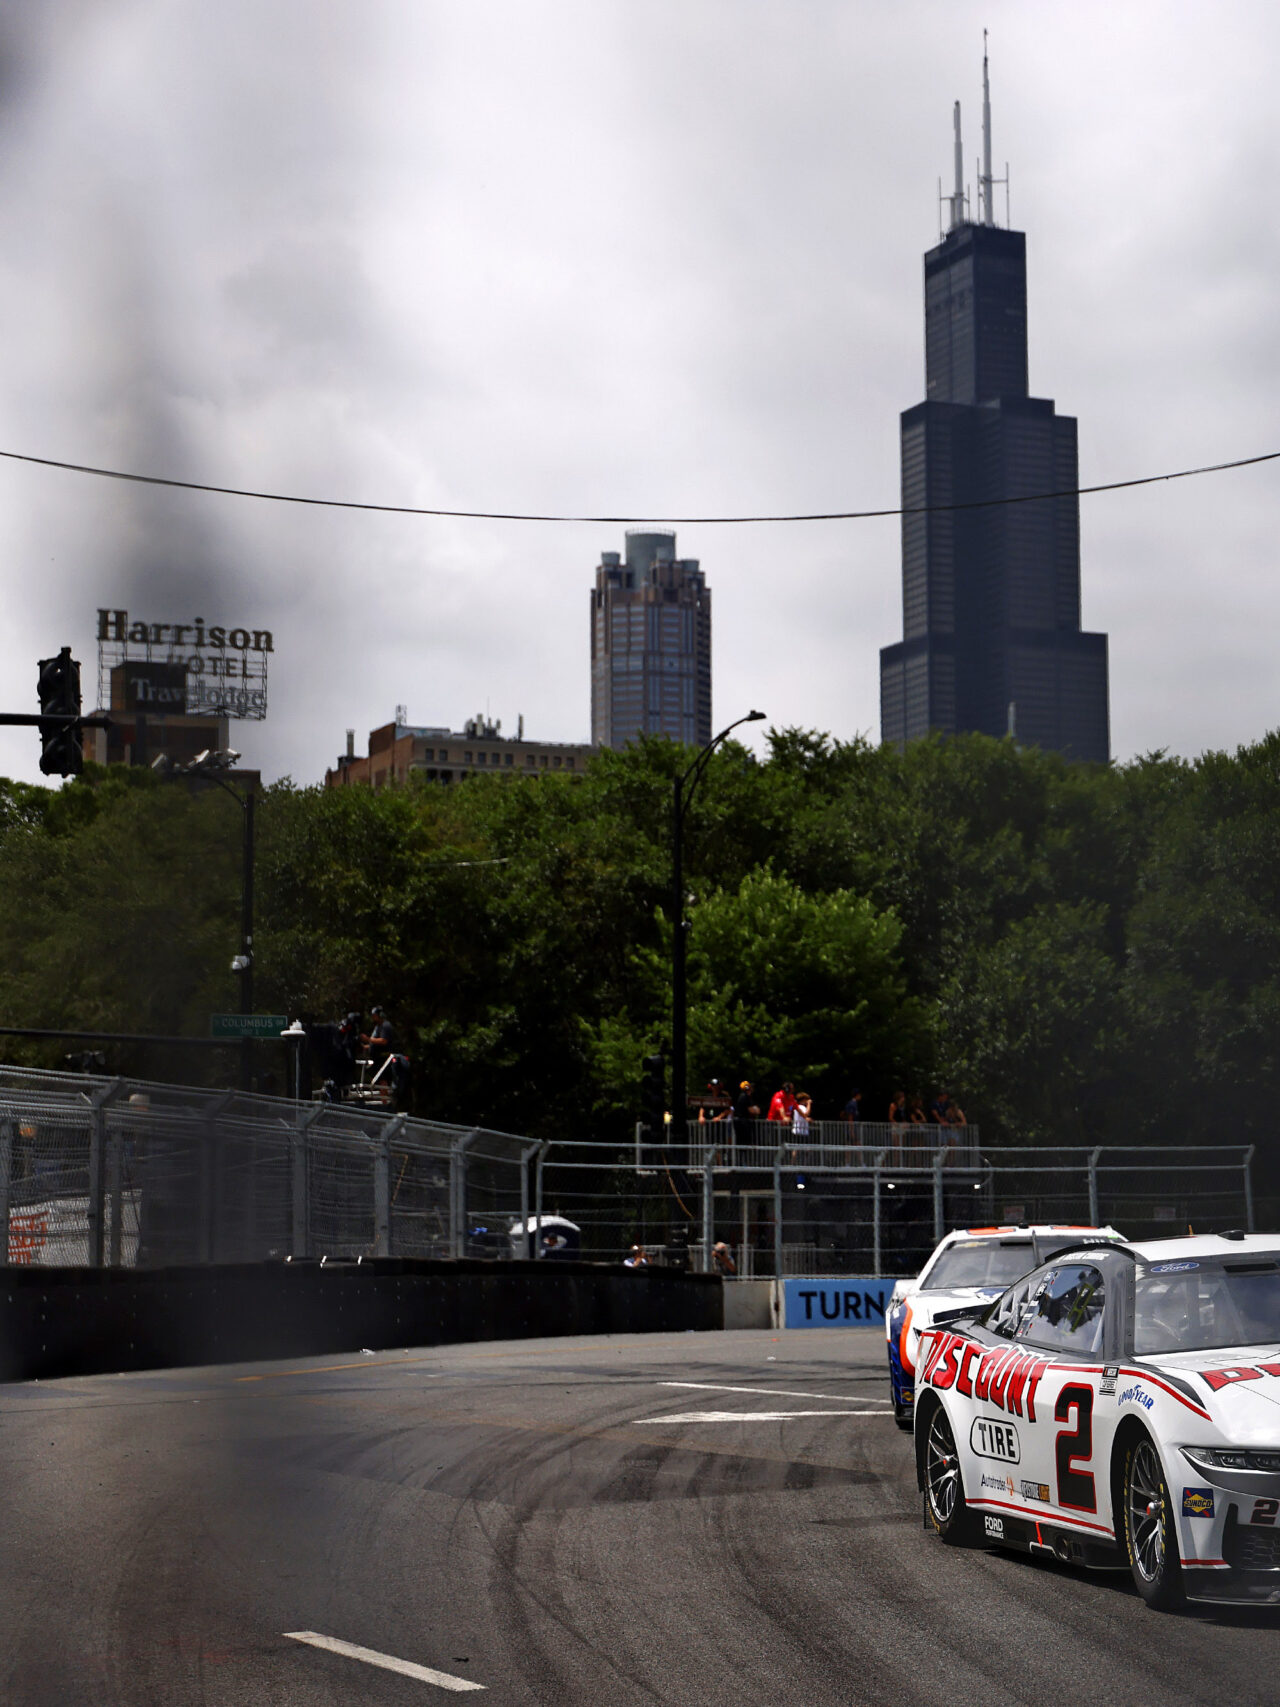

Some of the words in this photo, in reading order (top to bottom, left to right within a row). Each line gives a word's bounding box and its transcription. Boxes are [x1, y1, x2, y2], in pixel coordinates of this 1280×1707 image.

[97, 609, 274, 652] Harrison
[167, 654, 253, 679] HOTEL
[222, 1016, 273, 1028] COLUMBUS
[799, 1291, 885, 1320] TURN
[920, 1330, 1049, 1423] DISCOUNT
[978, 1422, 1016, 1458] TIRE
[1054, 1382, 1097, 1514] 2
[1184, 1499, 1212, 1508] SUNOCO
[1249, 1499, 1280, 1526] 2
[984, 1515, 1004, 1531] FORD
